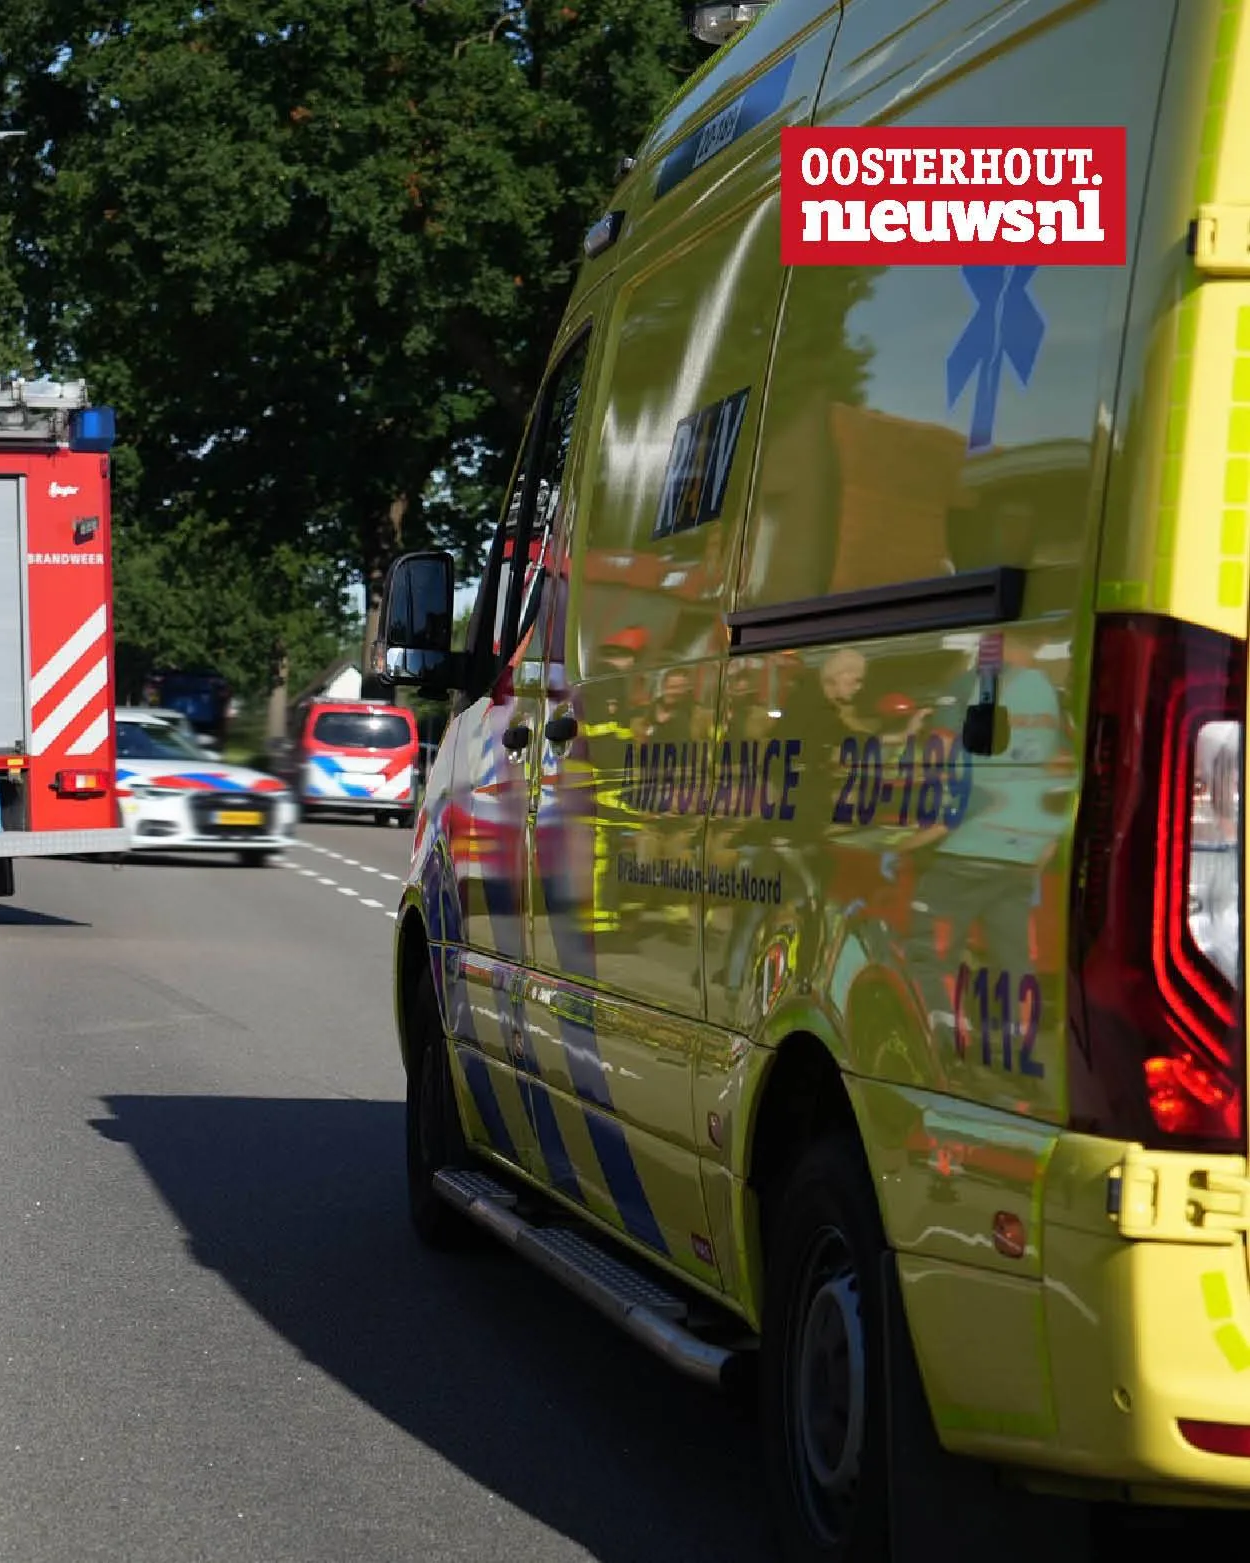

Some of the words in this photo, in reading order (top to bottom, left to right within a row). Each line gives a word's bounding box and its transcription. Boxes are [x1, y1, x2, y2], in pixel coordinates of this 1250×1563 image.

[27, 552, 104, 565] BRANDWEER
[620, 739, 801, 821] AMBULANCE
[832, 733, 974, 830] 20-189
[973, 966, 1045, 1079] 112
